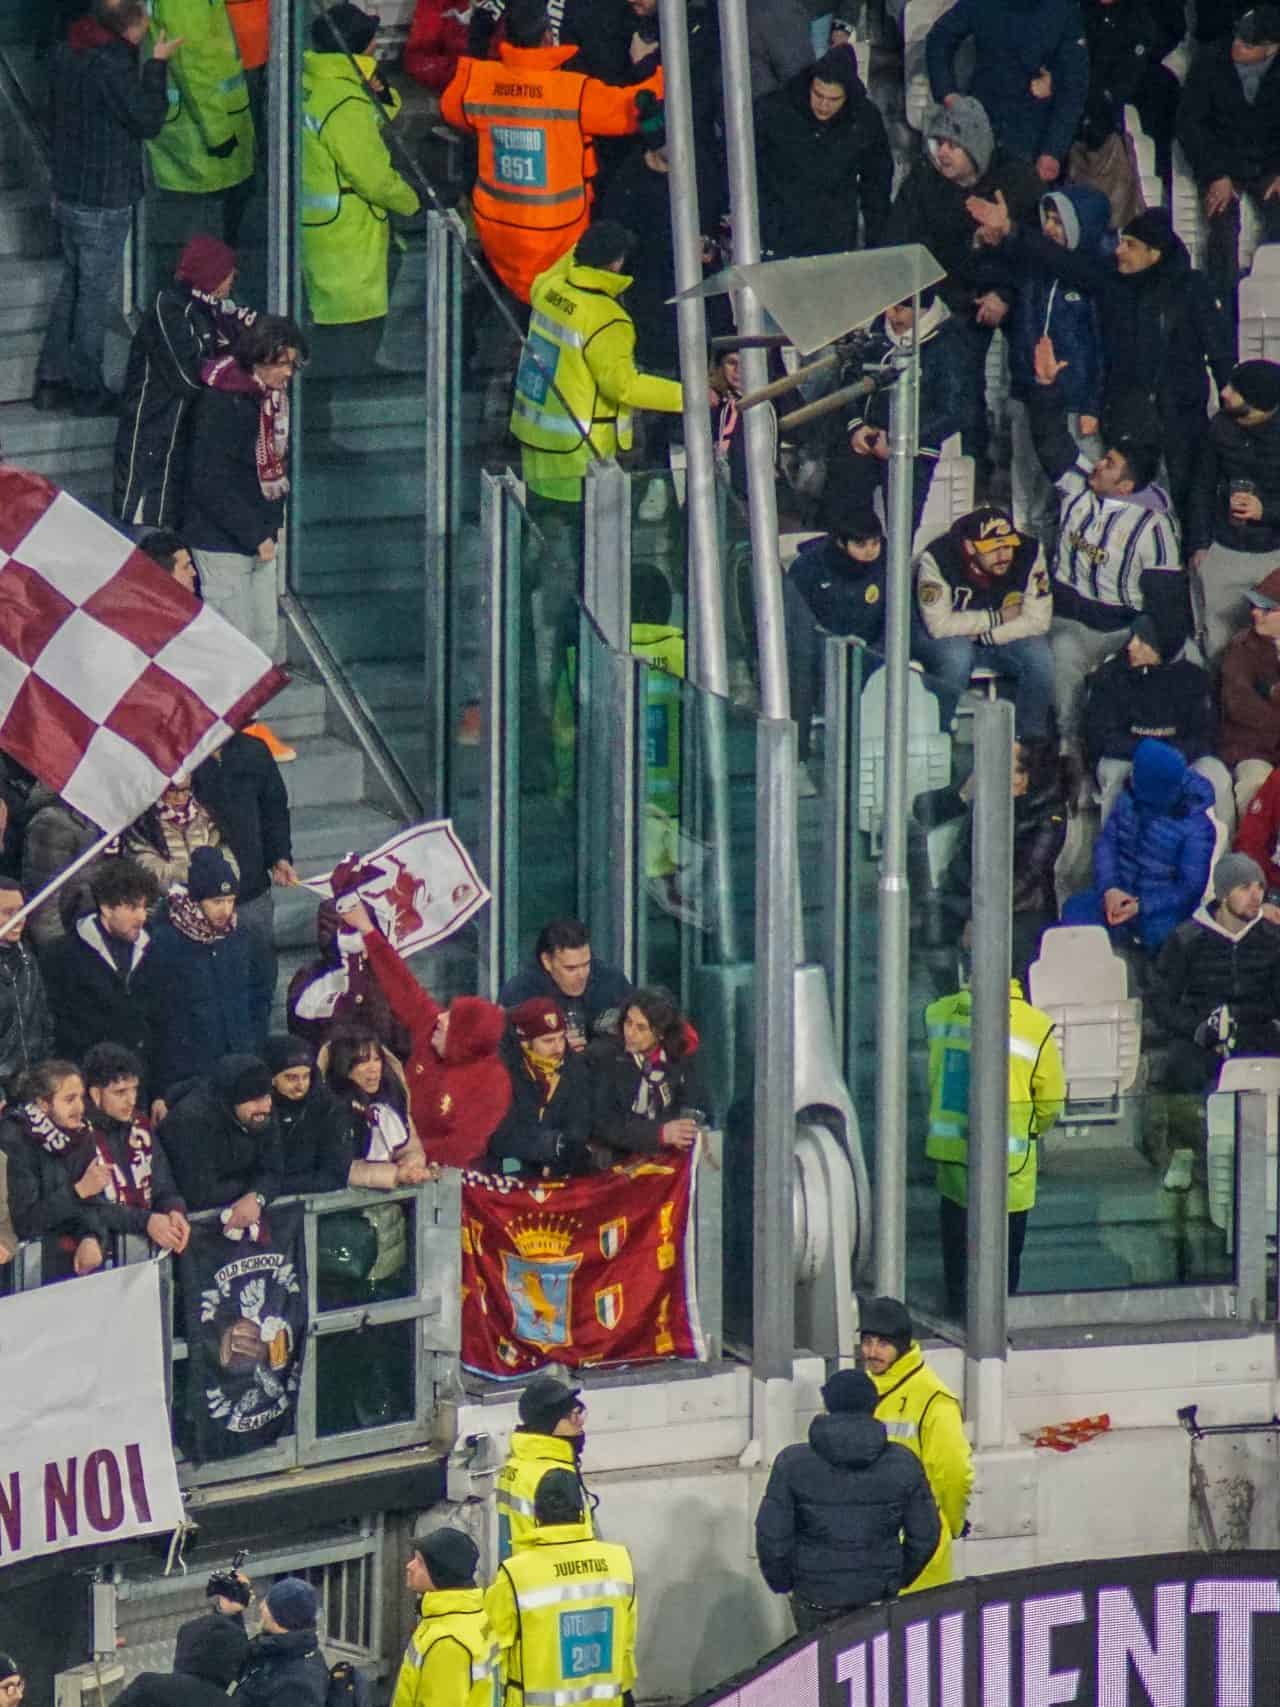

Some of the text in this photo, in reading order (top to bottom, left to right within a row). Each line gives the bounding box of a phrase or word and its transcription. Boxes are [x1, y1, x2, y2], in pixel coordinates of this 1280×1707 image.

[493, 83, 543, 98] JUVENTUS
[240, 1255, 281, 1273] SCHOOL
[44, 1443, 154, 1543] NOI
[553, 1558, 609, 1577] JUVENTUS
